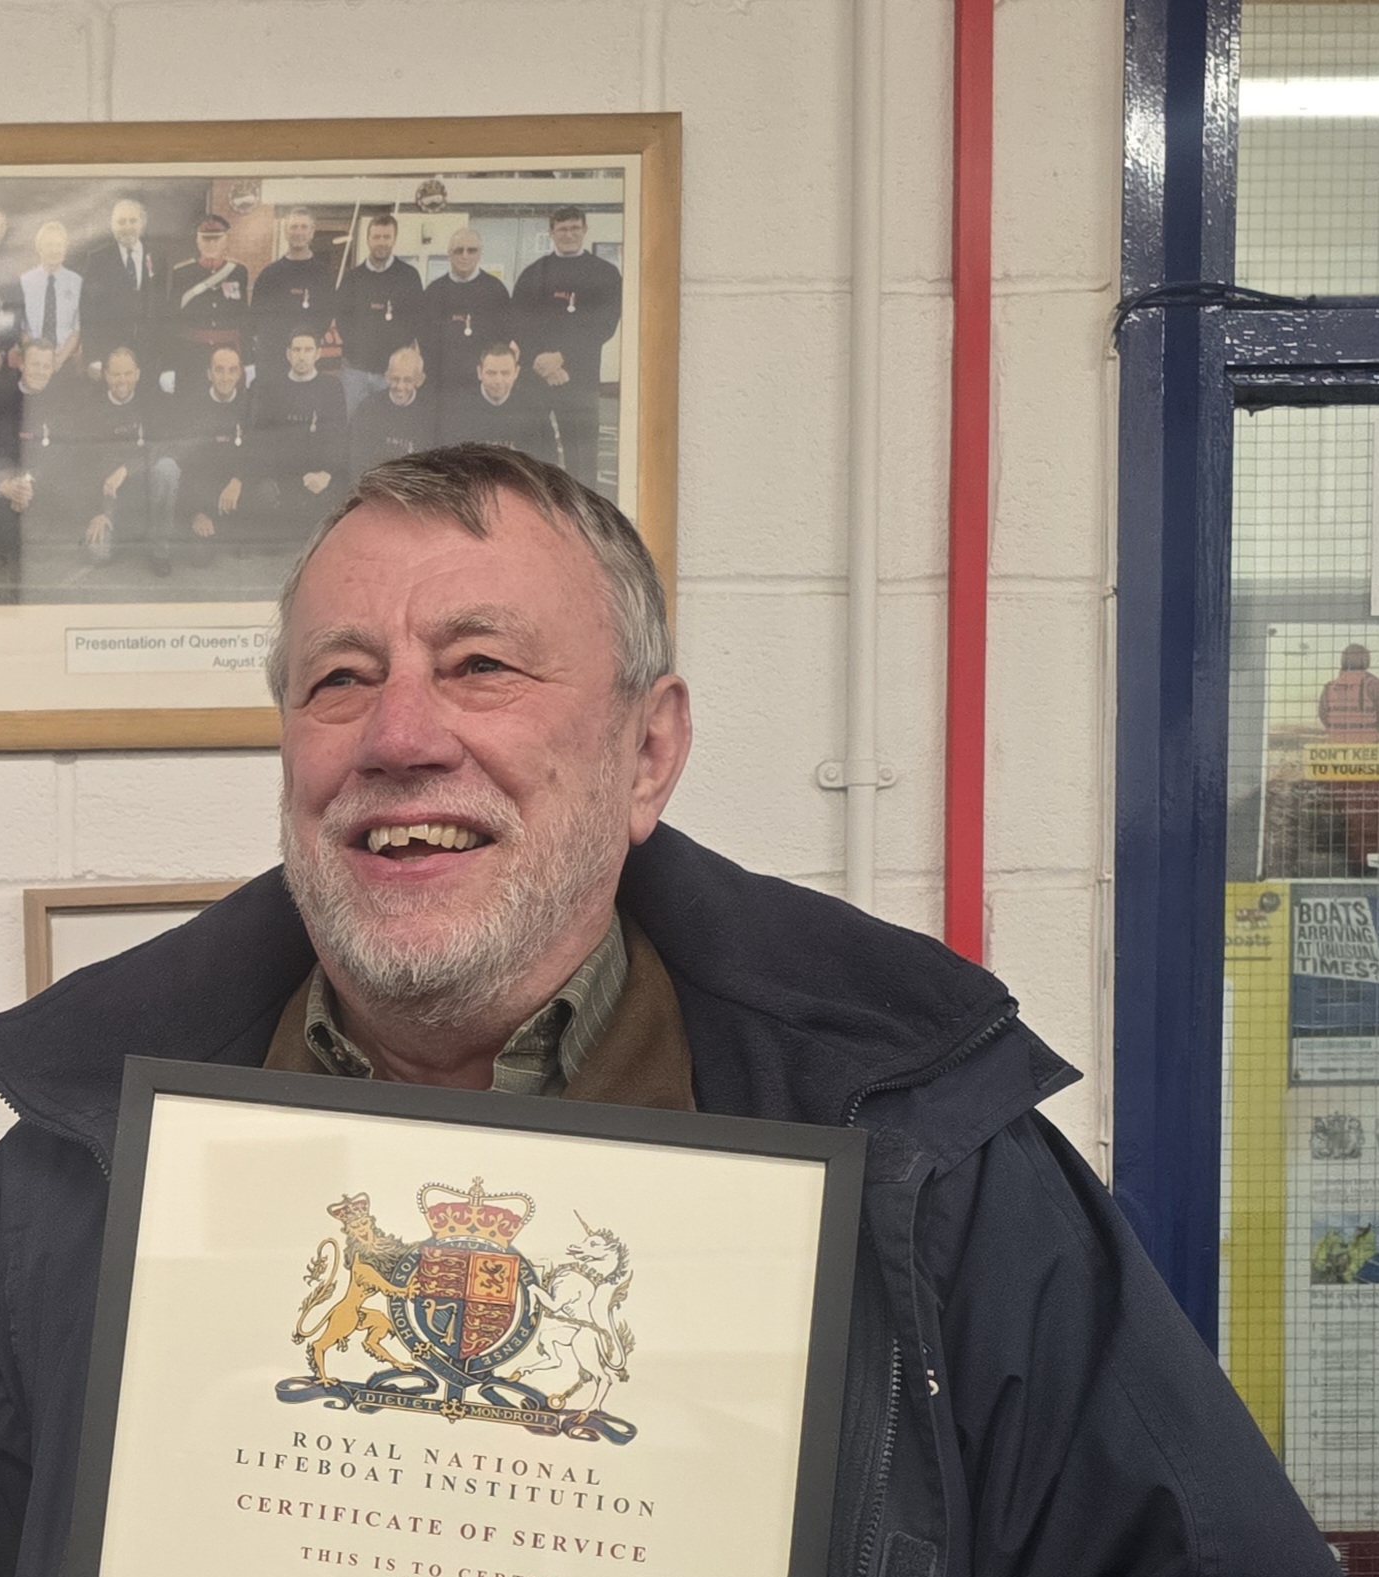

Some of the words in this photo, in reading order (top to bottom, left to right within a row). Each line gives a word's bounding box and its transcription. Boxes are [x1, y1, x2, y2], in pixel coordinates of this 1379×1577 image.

[75, 635, 166, 651] Presentation
[170, 634, 185, 649] of
[188, 634, 249, 650] Queen's
[212, 656, 256, 671] August
[1309, 765, 1328, 775] TO
[1299, 901, 1369, 926] BOATS
[1298, 926, 1375, 944] ARRIVING
[1297, 942, 1312, 956] AT
[1315, 942, 1379, 962] UNUSUAL
[481, 1326, 530, 1366] PENSE
[292, 1431, 403, 1460] ROYAL
[424, 1448, 602, 1486] NATIONAL
[236, 1448, 404, 1486] LIFEBOAT
[424, 1472, 656, 1518] INSTITUTION
[236, 1493, 444, 1536] CERTIFICATE
[460, 1523, 498, 1543] OF
[512, 1529, 648, 1563] SERVICE
[300, 1546, 359, 1567] THIS
[374, 1555, 397, 1571] IS
[412, 1561, 443, 1577] TO
